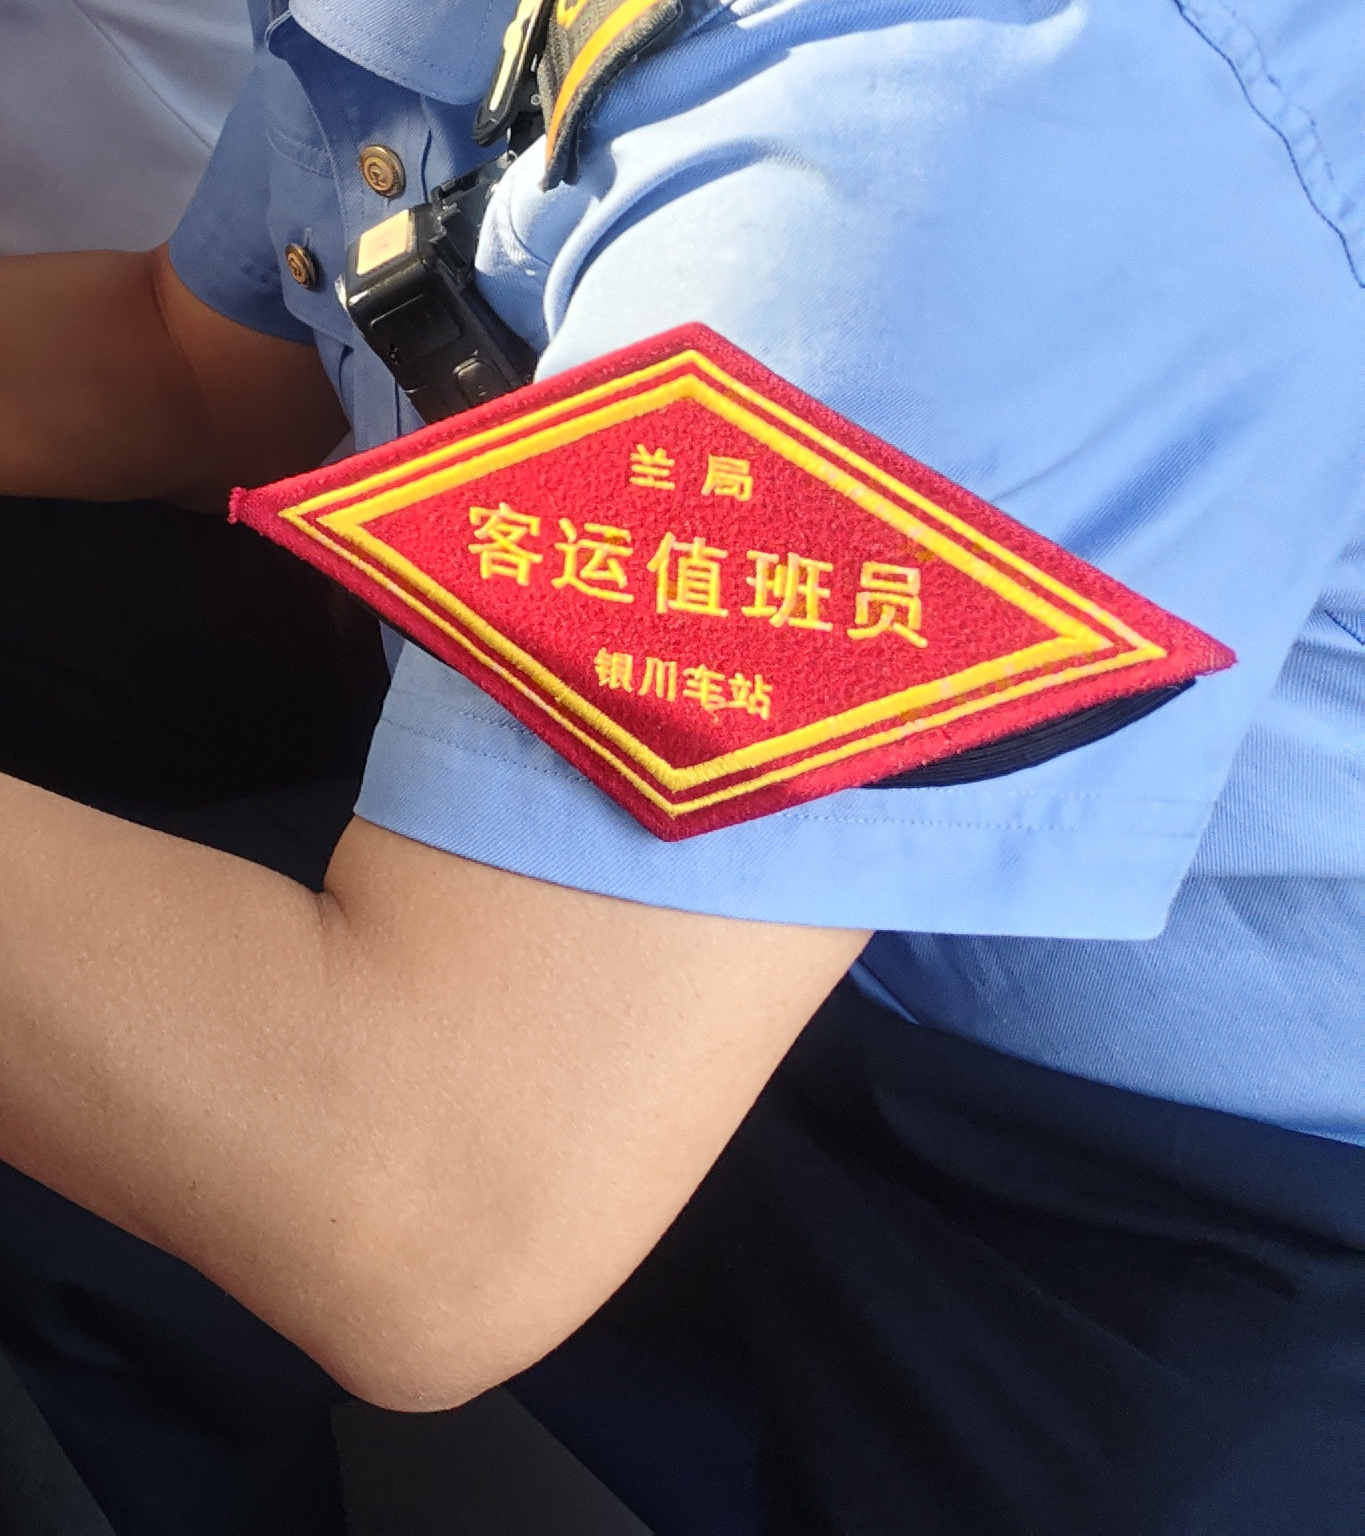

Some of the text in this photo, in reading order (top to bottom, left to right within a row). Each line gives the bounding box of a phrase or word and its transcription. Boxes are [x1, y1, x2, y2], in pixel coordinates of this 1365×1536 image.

[467, 500, 928, 649] 客运值班员
[593, 646, 773, 720] 银川车站
